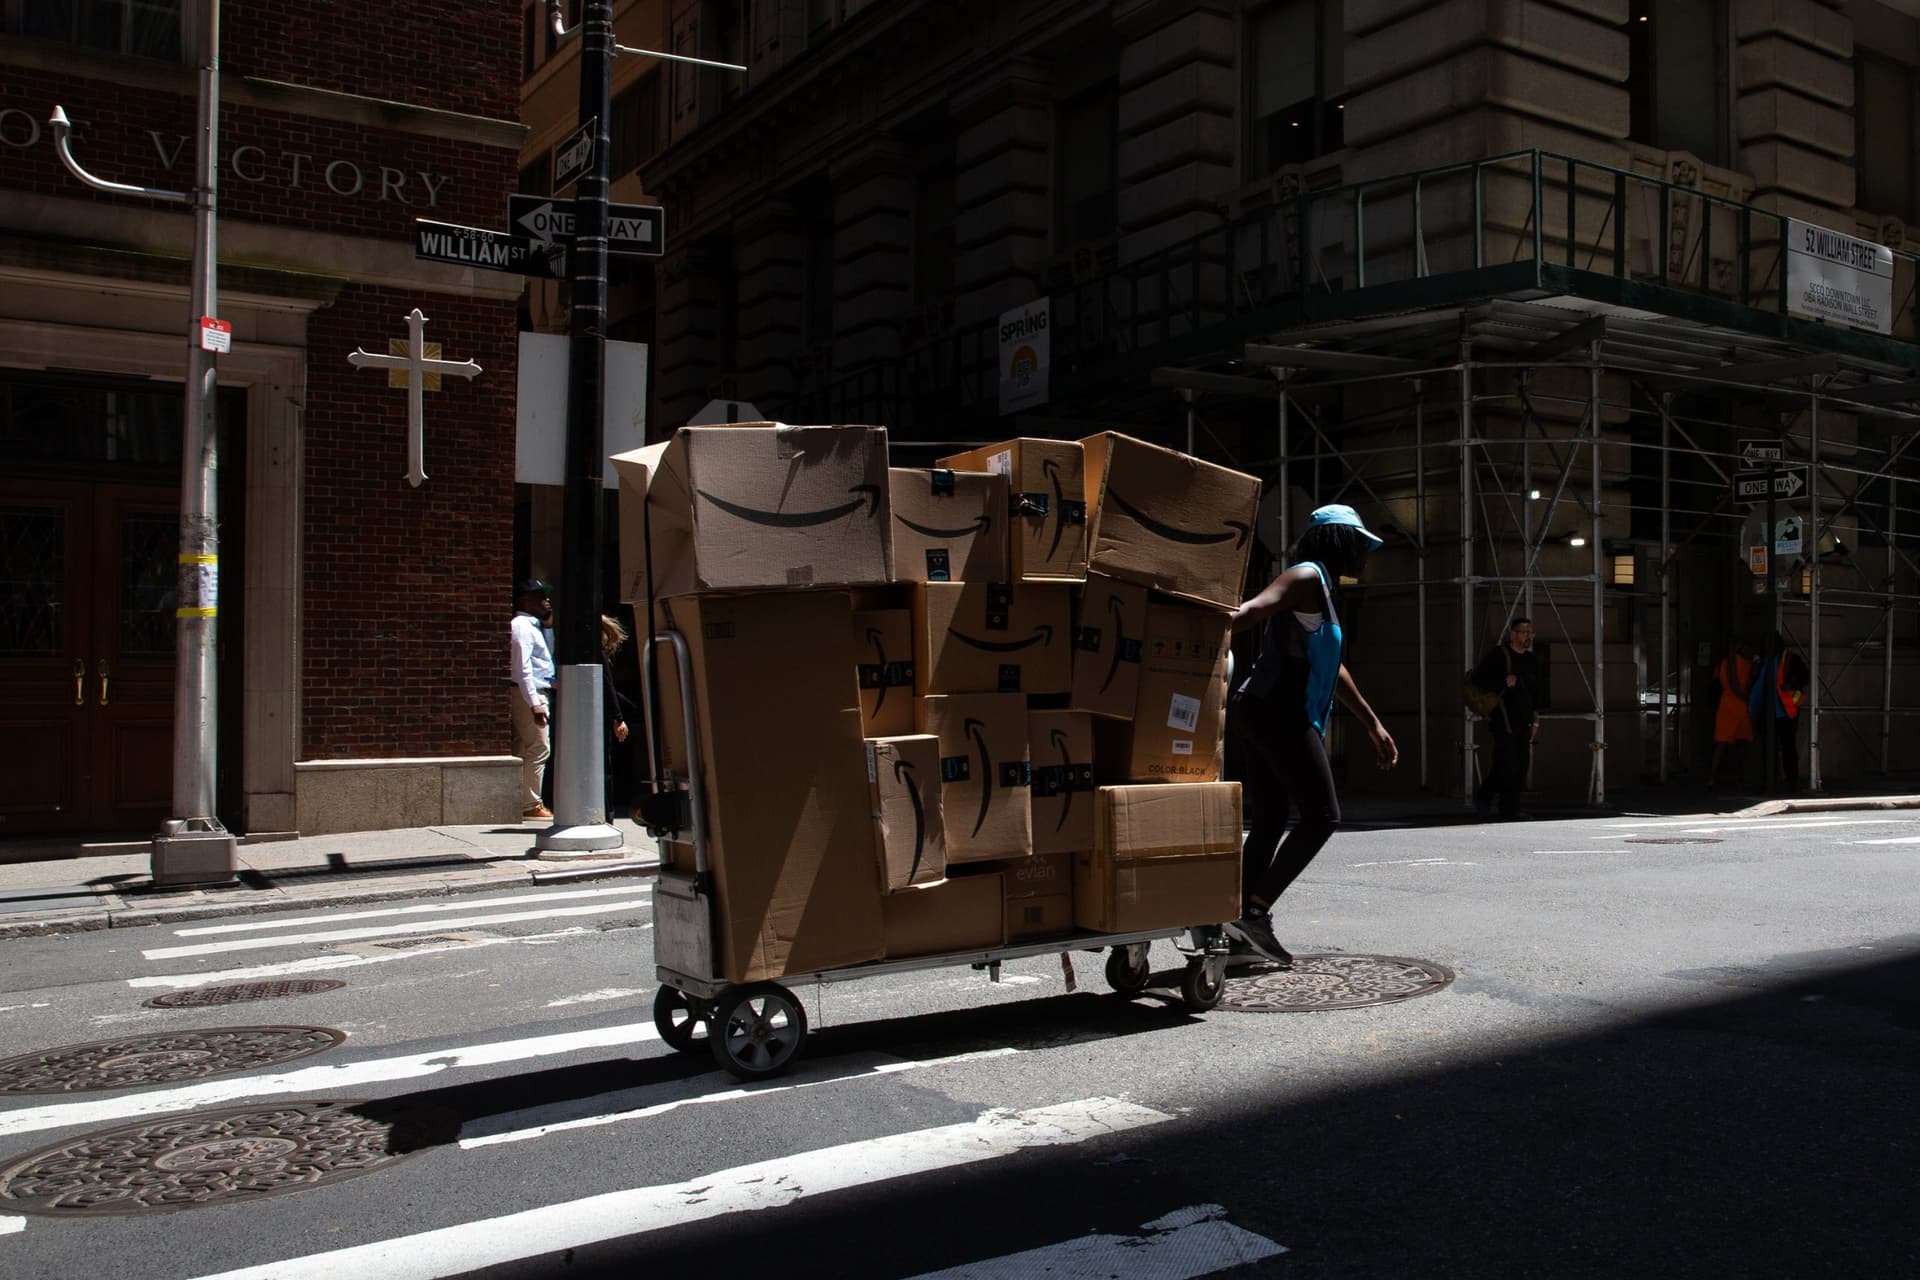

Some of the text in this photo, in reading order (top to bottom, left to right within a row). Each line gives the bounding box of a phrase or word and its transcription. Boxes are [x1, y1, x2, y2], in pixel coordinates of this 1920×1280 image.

[146, 129, 450, 208] VCTORY
[534, 212, 576, 234] ONE
[420, 231, 526, 266] WILLIAM ST
[1806, 228, 1877, 272] 52 WILLIAM STREET
[1001, 308, 1046, 342] SPRING
[1858, 306, 1878, 320] STREET
[1744, 479, 1797, 494] ONE WAY
